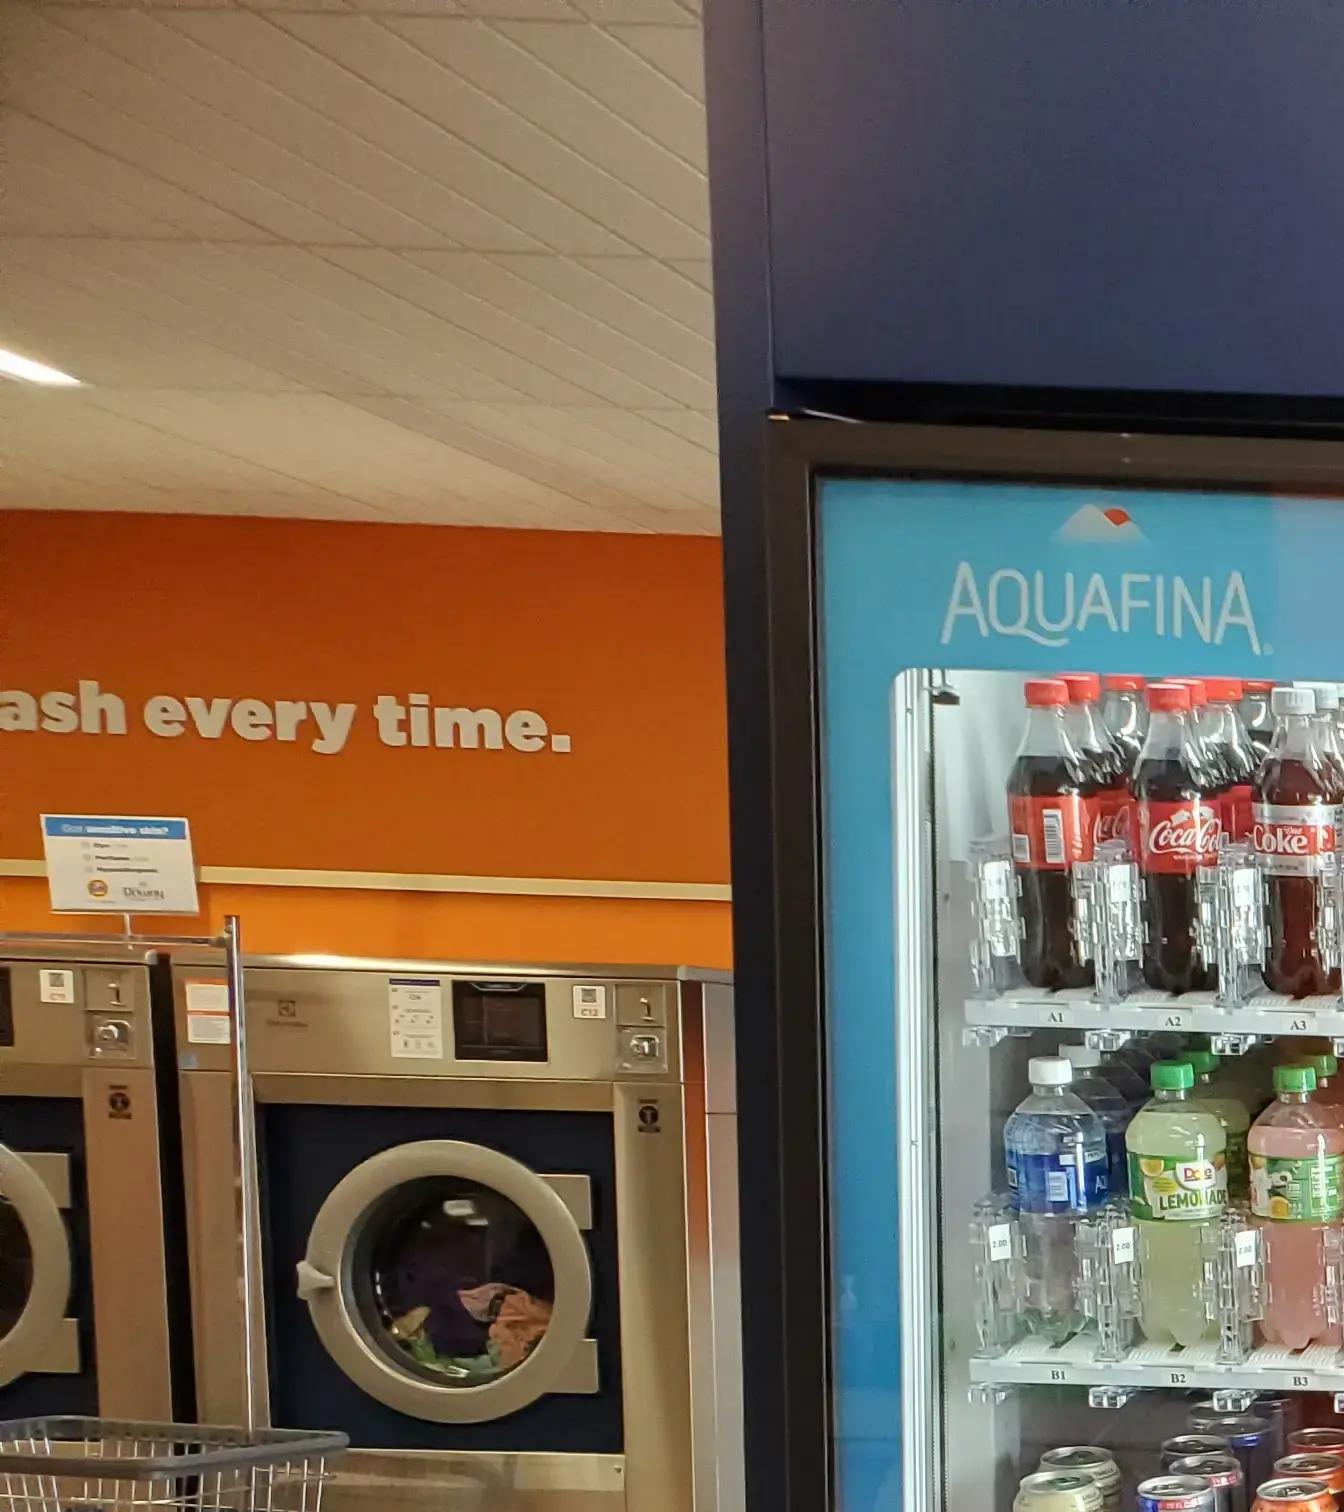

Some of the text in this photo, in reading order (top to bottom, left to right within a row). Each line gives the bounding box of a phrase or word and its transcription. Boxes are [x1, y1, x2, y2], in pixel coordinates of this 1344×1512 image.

[940, 560, 1264, 656] AQUAFINA
[143, 694, 358, 755] every
[373, 693, 572, 754] time.
[1149, 818, 1222, 853] CocaCol
[1252, 824, 1308, 854] Coke
[1047, 1011, 1064, 1023] A1
[1164, 1015, 1182, 1027] A2
[1290, 1020, 1308, 1031] A3
[992, 1239, 1007, 1248] 2.00
[1116, 1242, 1130, 1251] 2.00
[1050, 1370, 1066, 1381] B1
[1170, 1373, 1187, 1384] B2
[1293, 1376, 1309, 1387] B3
